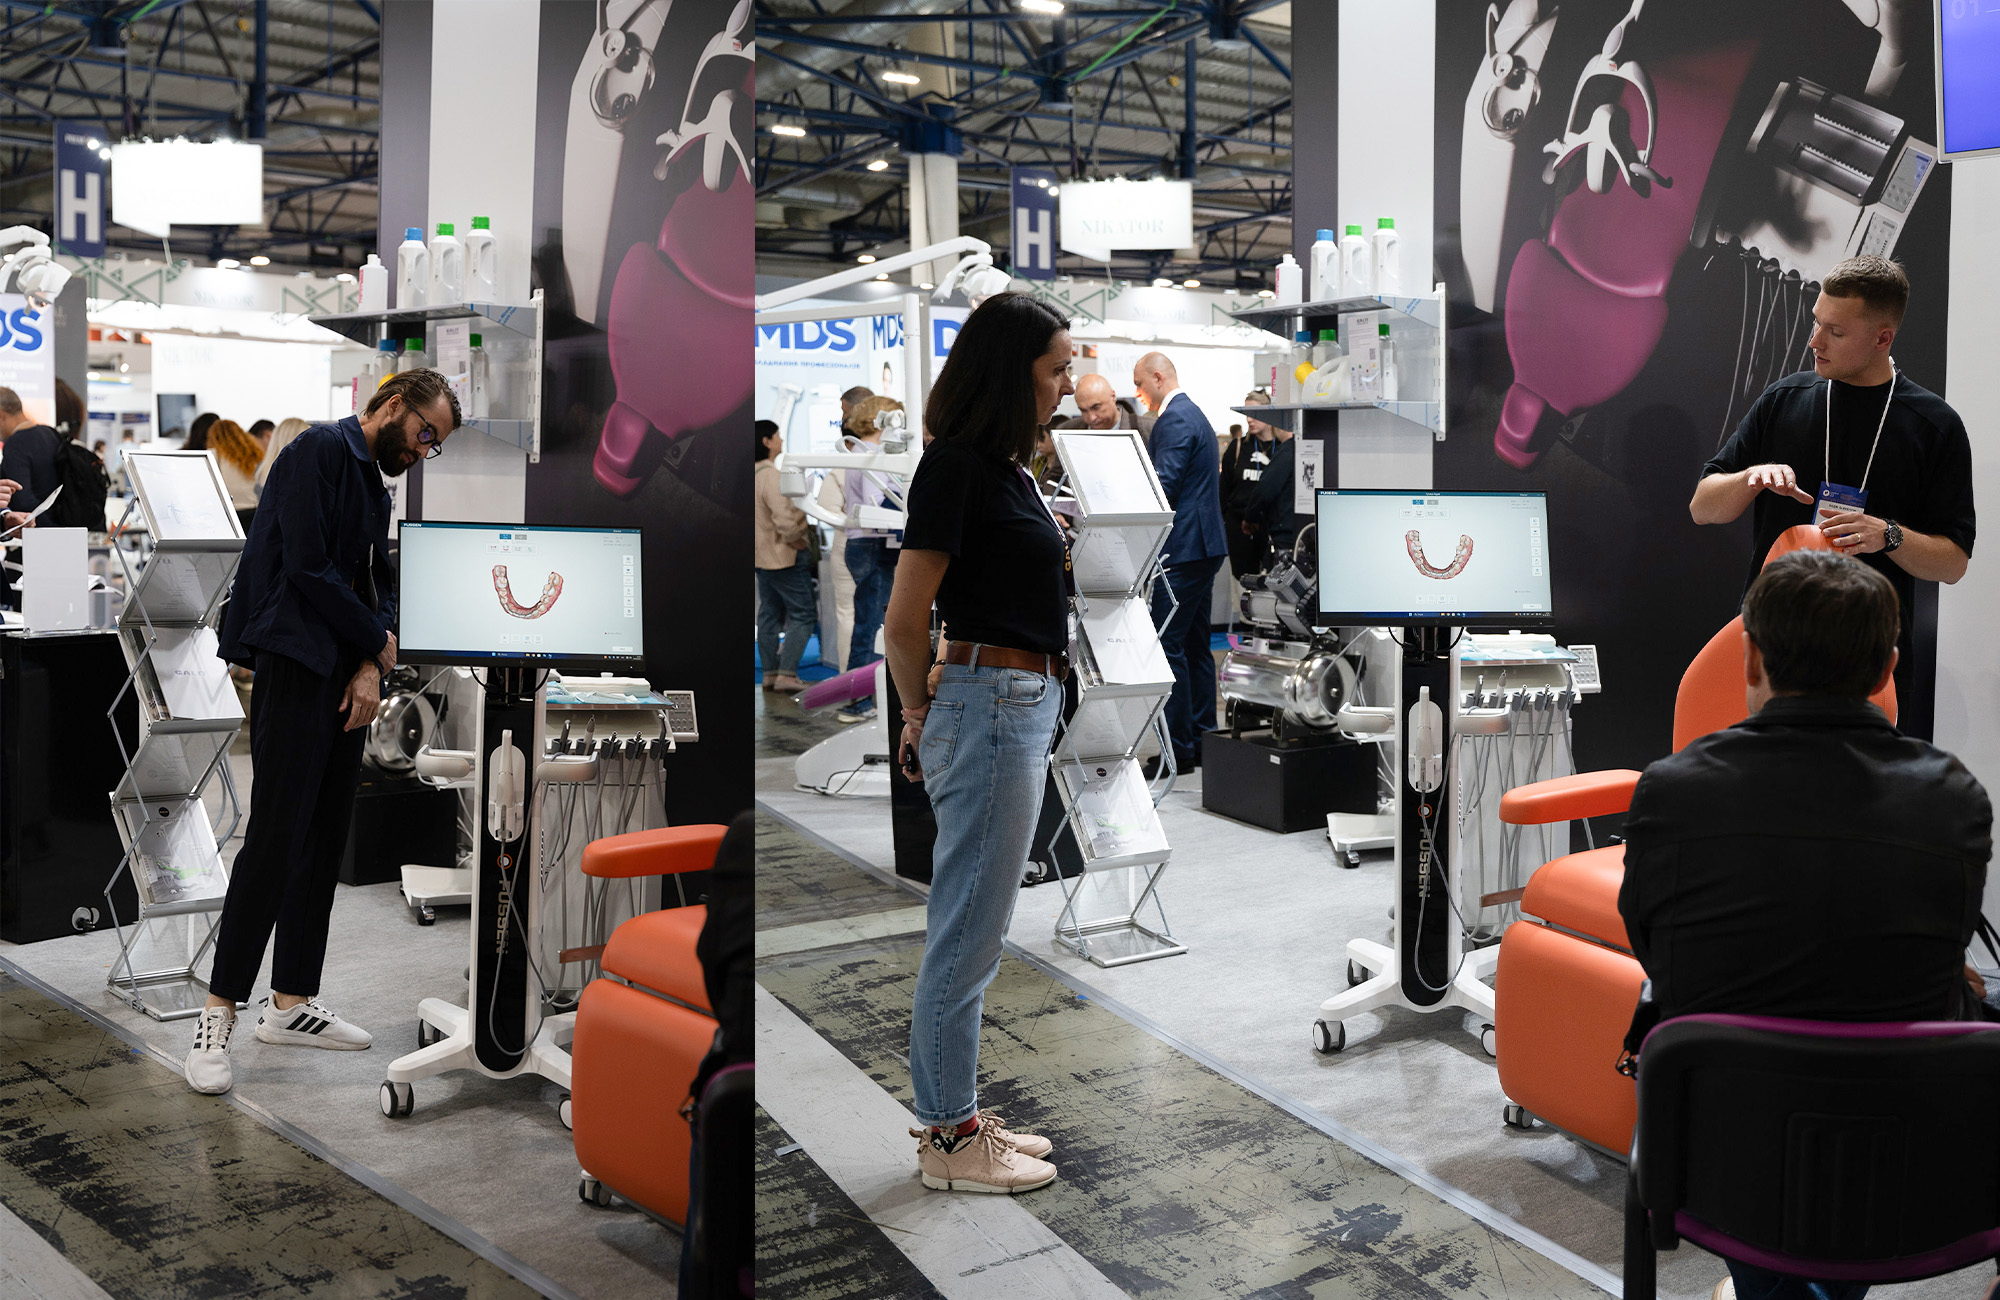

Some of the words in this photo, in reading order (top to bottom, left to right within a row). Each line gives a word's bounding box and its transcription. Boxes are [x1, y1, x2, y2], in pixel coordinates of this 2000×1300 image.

[61, 168, 100, 243] H
[1081, 219, 1164, 235] NIKATOR
[1016, 207, 1051, 270] H
